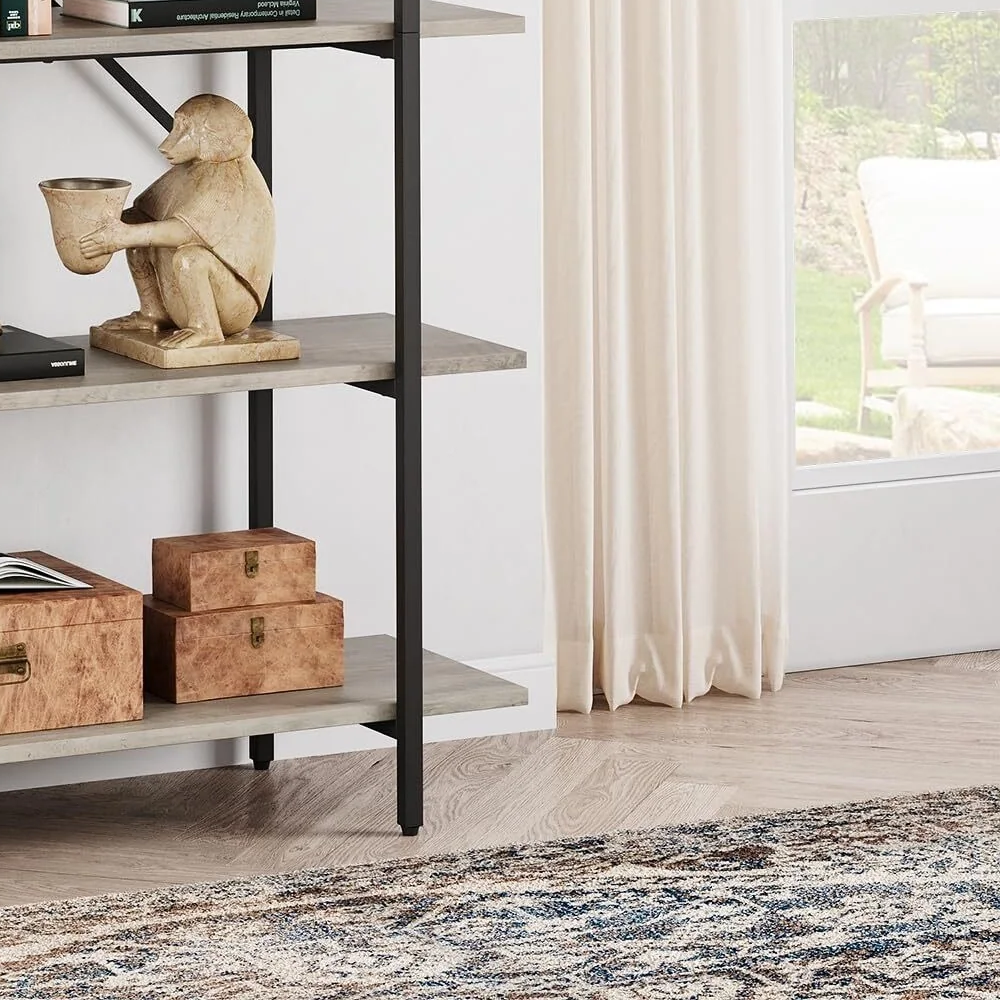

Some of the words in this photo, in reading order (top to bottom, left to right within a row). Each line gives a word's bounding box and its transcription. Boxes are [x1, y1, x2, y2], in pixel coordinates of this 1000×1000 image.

[279, 0, 300, 8] Virginia
[176, 13, 209, 21] Architecture
[210, 12, 239, 20] Residential
[240, 9, 278, 18] Contemporary
[284, 9, 300, 17] Detail
